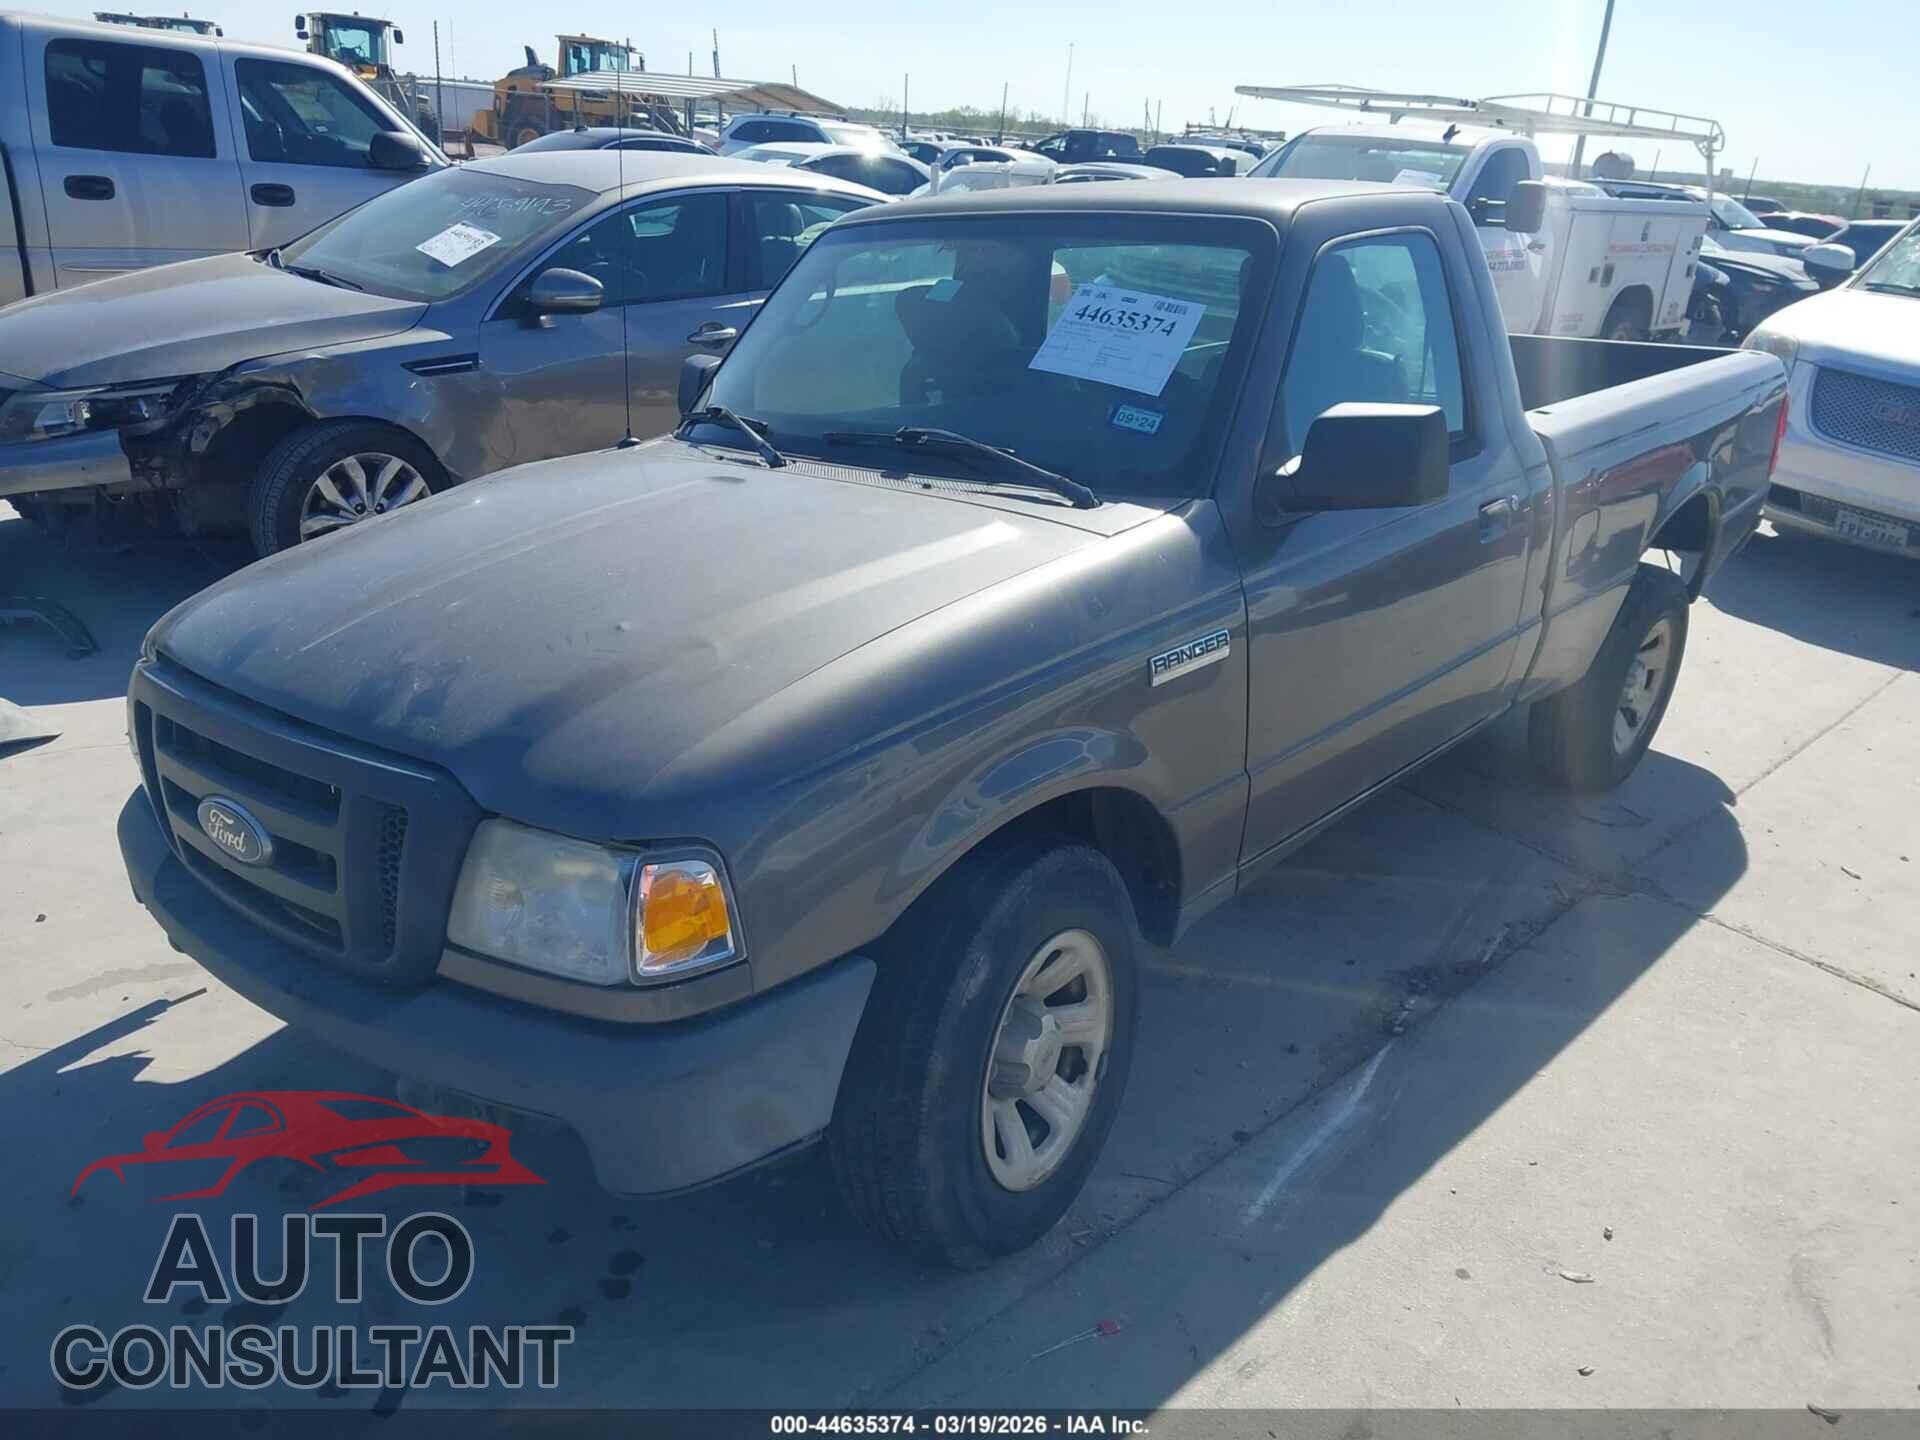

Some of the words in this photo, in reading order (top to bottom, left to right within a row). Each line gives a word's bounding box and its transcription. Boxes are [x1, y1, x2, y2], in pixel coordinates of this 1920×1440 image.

[1075, 304, 1177, 337] 44635374
[1153, 632, 1228, 674] RANGER
[208, 809, 246, 853] Ford
